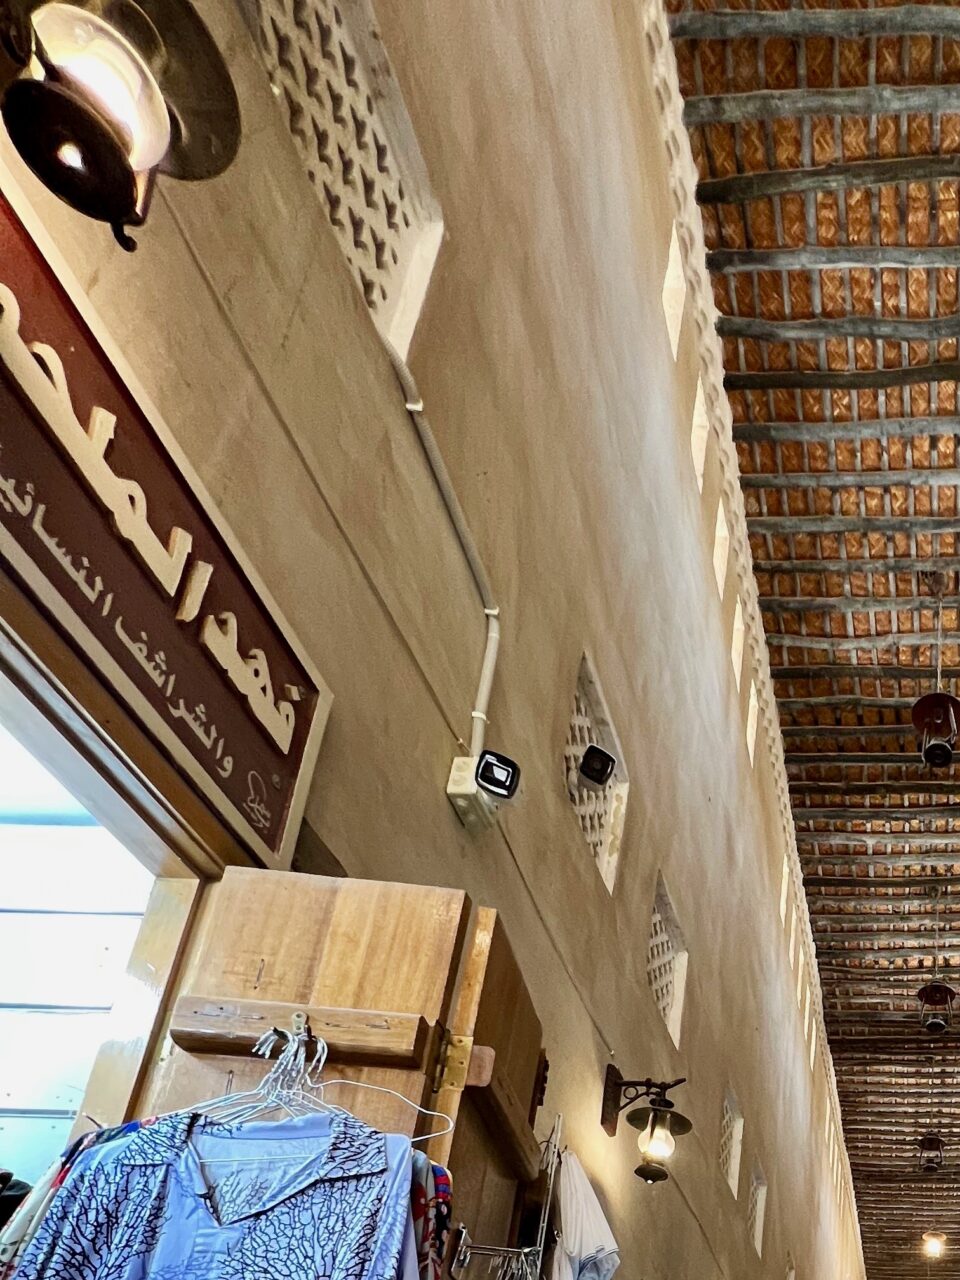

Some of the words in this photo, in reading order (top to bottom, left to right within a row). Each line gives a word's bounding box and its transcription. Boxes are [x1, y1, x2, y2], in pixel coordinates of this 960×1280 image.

[0, 473, 113, 617] النسائي
[115, 614, 233, 780] والشراشف
[200, 610, 305, 756] فهد
